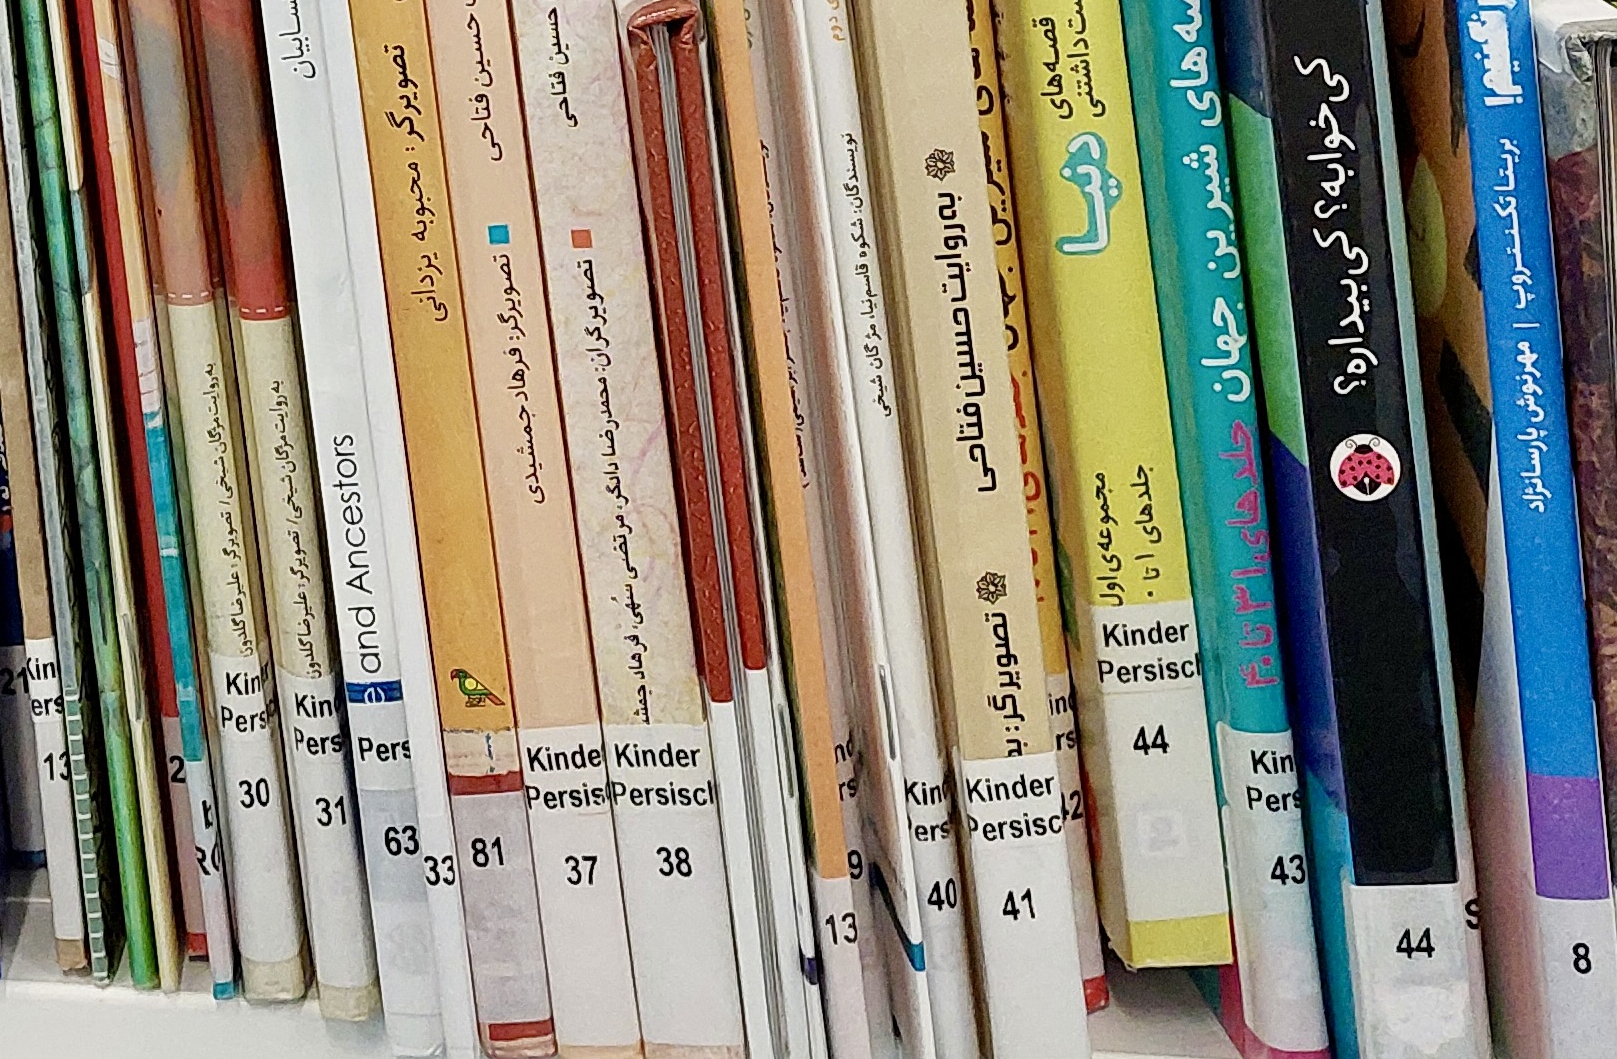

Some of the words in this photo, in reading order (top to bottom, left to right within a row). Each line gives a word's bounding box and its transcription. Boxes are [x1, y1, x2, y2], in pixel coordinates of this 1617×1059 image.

[467, 12, 493, 88] حسین
[547, 6, 570, 65] حسین
[1294, 55, 1349, 102] کی
[549, 70, 578, 128] فتاحی
[469, 93, 503, 161] فتاحی
[938, 192, 963, 221] به
[934, 221, 971, 303] روایت
[1313, 229, 1368, 274] کی
[953, 307, 986, 397] حسین
[503, 346, 530, 402] فرهاد
[516, 404, 545, 504] جمشیدی
[956, 402, 997, 492] فتاحی
[333, 434, 373, 594] Ancestors
[348, 606, 382, 673] and
[1102, 621, 1189, 648] Kinder
[615, 742, 701, 767] Kinder
[1133, 725, 1169, 756] 44
[239, 778, 270, 808] 30
[966, 774, 1055, 803] Kinder
[316, 797, 346, 827] 31
[385, 826, 419, 856] 63
[471, 837, 505, 867] 81
[423, 856, 455, 886] 33
[565, 856, 598, 886] 37
[656, 847, 693, 877] 38
[1270, 854, 1306, 885] 43
[928, 878, 957, 911] 40
[1003, 889, 1035, 920] 41
[825, 912, 858, 945] 13
[1396, 928, 1435, 958] 44
[1573, 943, 1591, 974] 8
